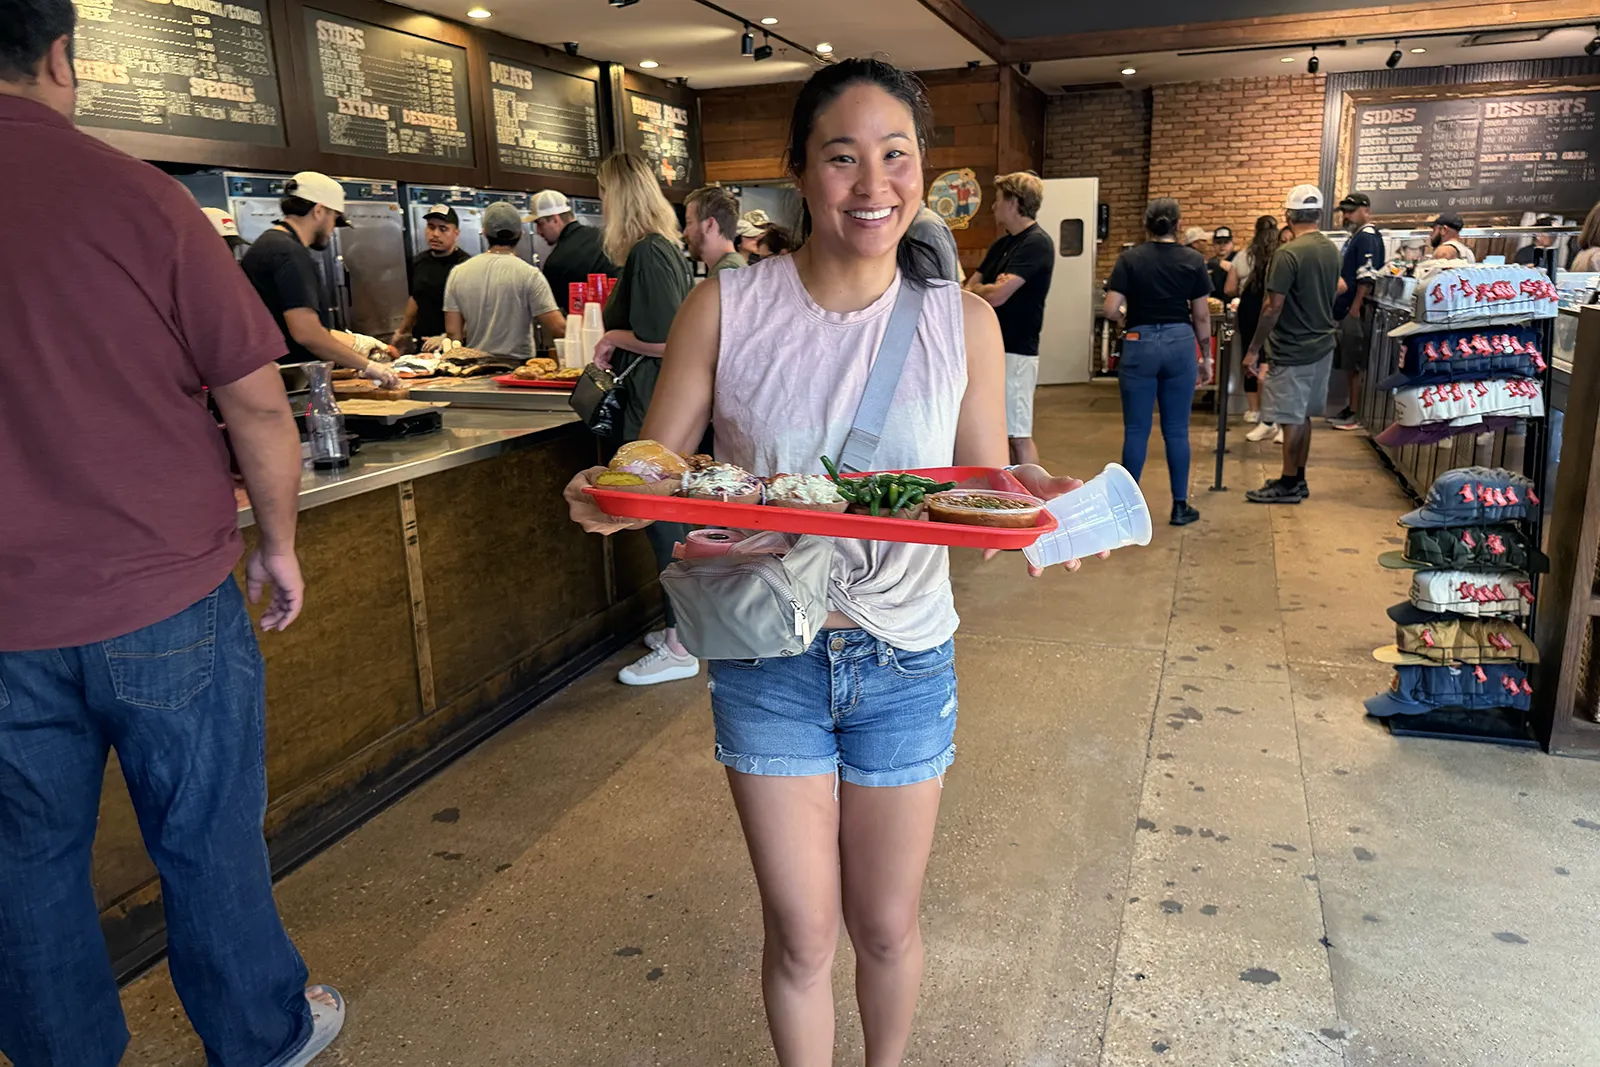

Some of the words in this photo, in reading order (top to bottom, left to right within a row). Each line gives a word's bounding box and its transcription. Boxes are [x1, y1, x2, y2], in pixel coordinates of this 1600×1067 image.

[316, 19, 366, 50] SIDES
[490, 61, 533, 90] MEATS
[336, 96, 390, 120] EXTRAS
[1361, 108, 1417, 125] SIDES
[1485, 97, 1587, 119] DESSERTS
[402, 108, 458, 131] DESSERTS
[1388, 135, 1418, 145] BEANS
[1387, 162, 1419, 172] BEANS
